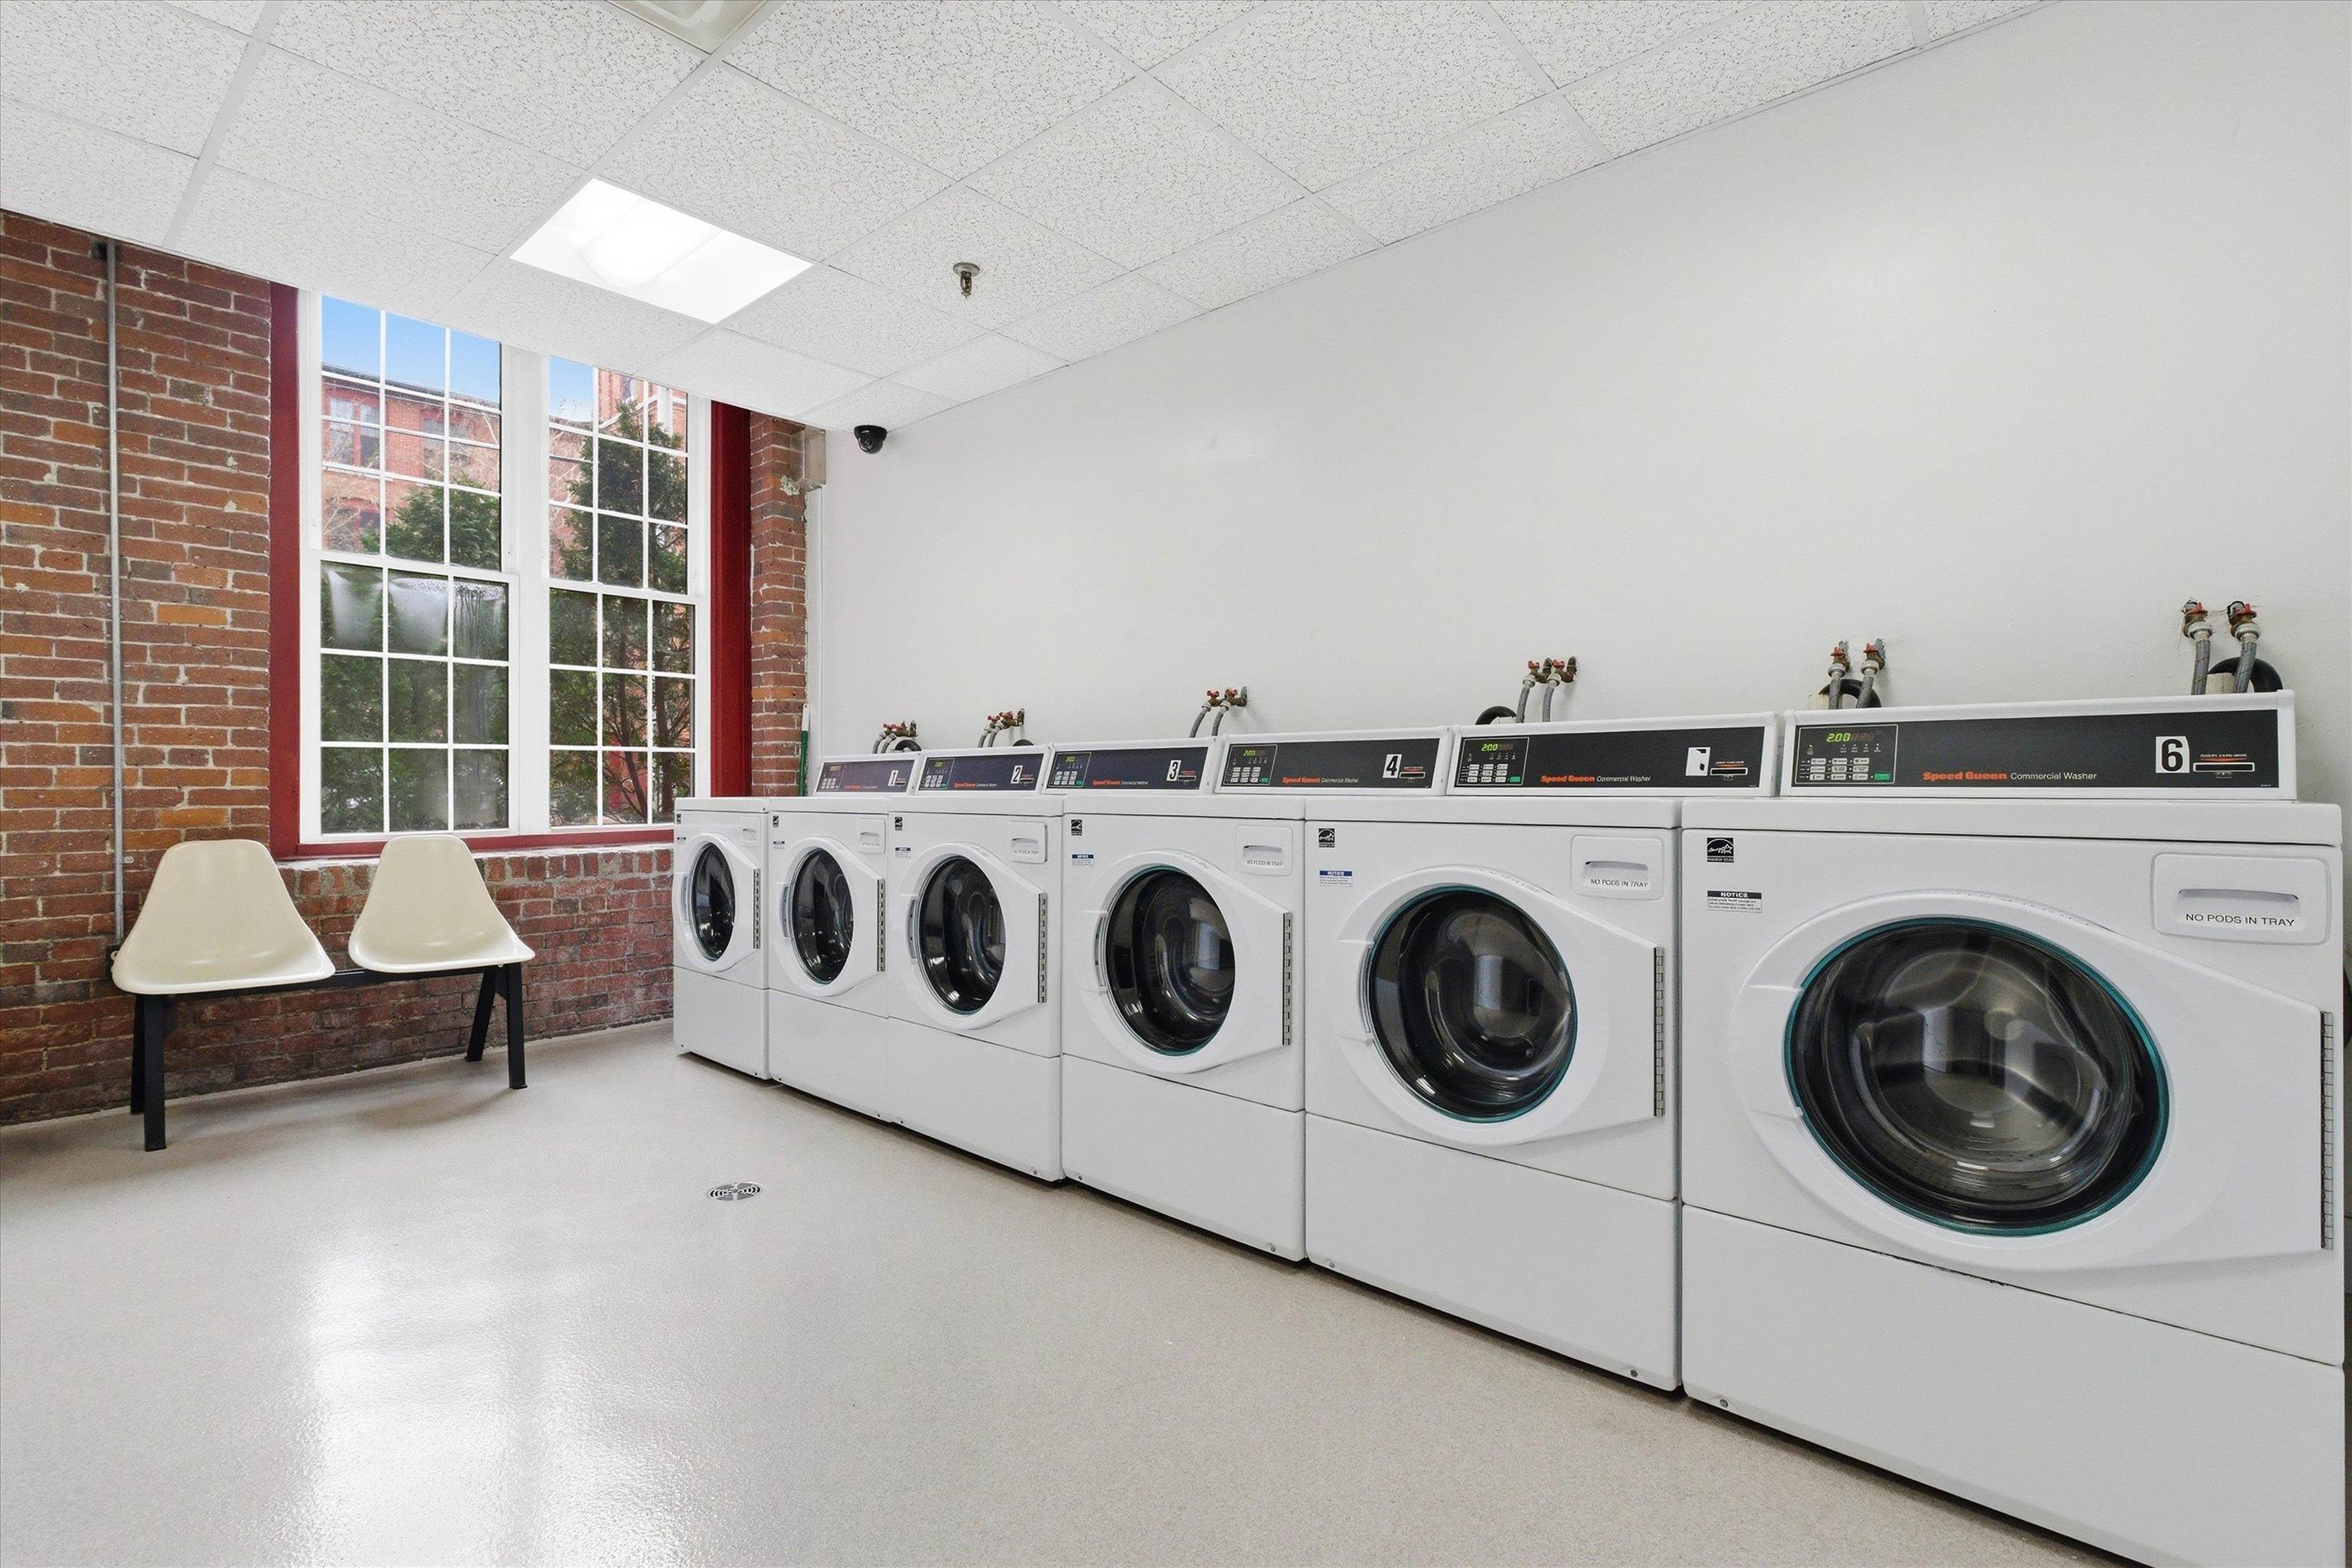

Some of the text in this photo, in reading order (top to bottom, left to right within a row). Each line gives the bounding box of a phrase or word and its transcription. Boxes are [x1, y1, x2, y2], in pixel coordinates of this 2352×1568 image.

[2161, 738, 2184, 772] 6
[1012, 766, 1021, 784] 2
[1169, 761, 1179, 780] 3
[1386, 756, 1399, 776] 4
[1922, 771, 2098, 782] Speed Queen Commercial Washer
[2186, 913, 2295, 926] NO PODS IN TRAY
